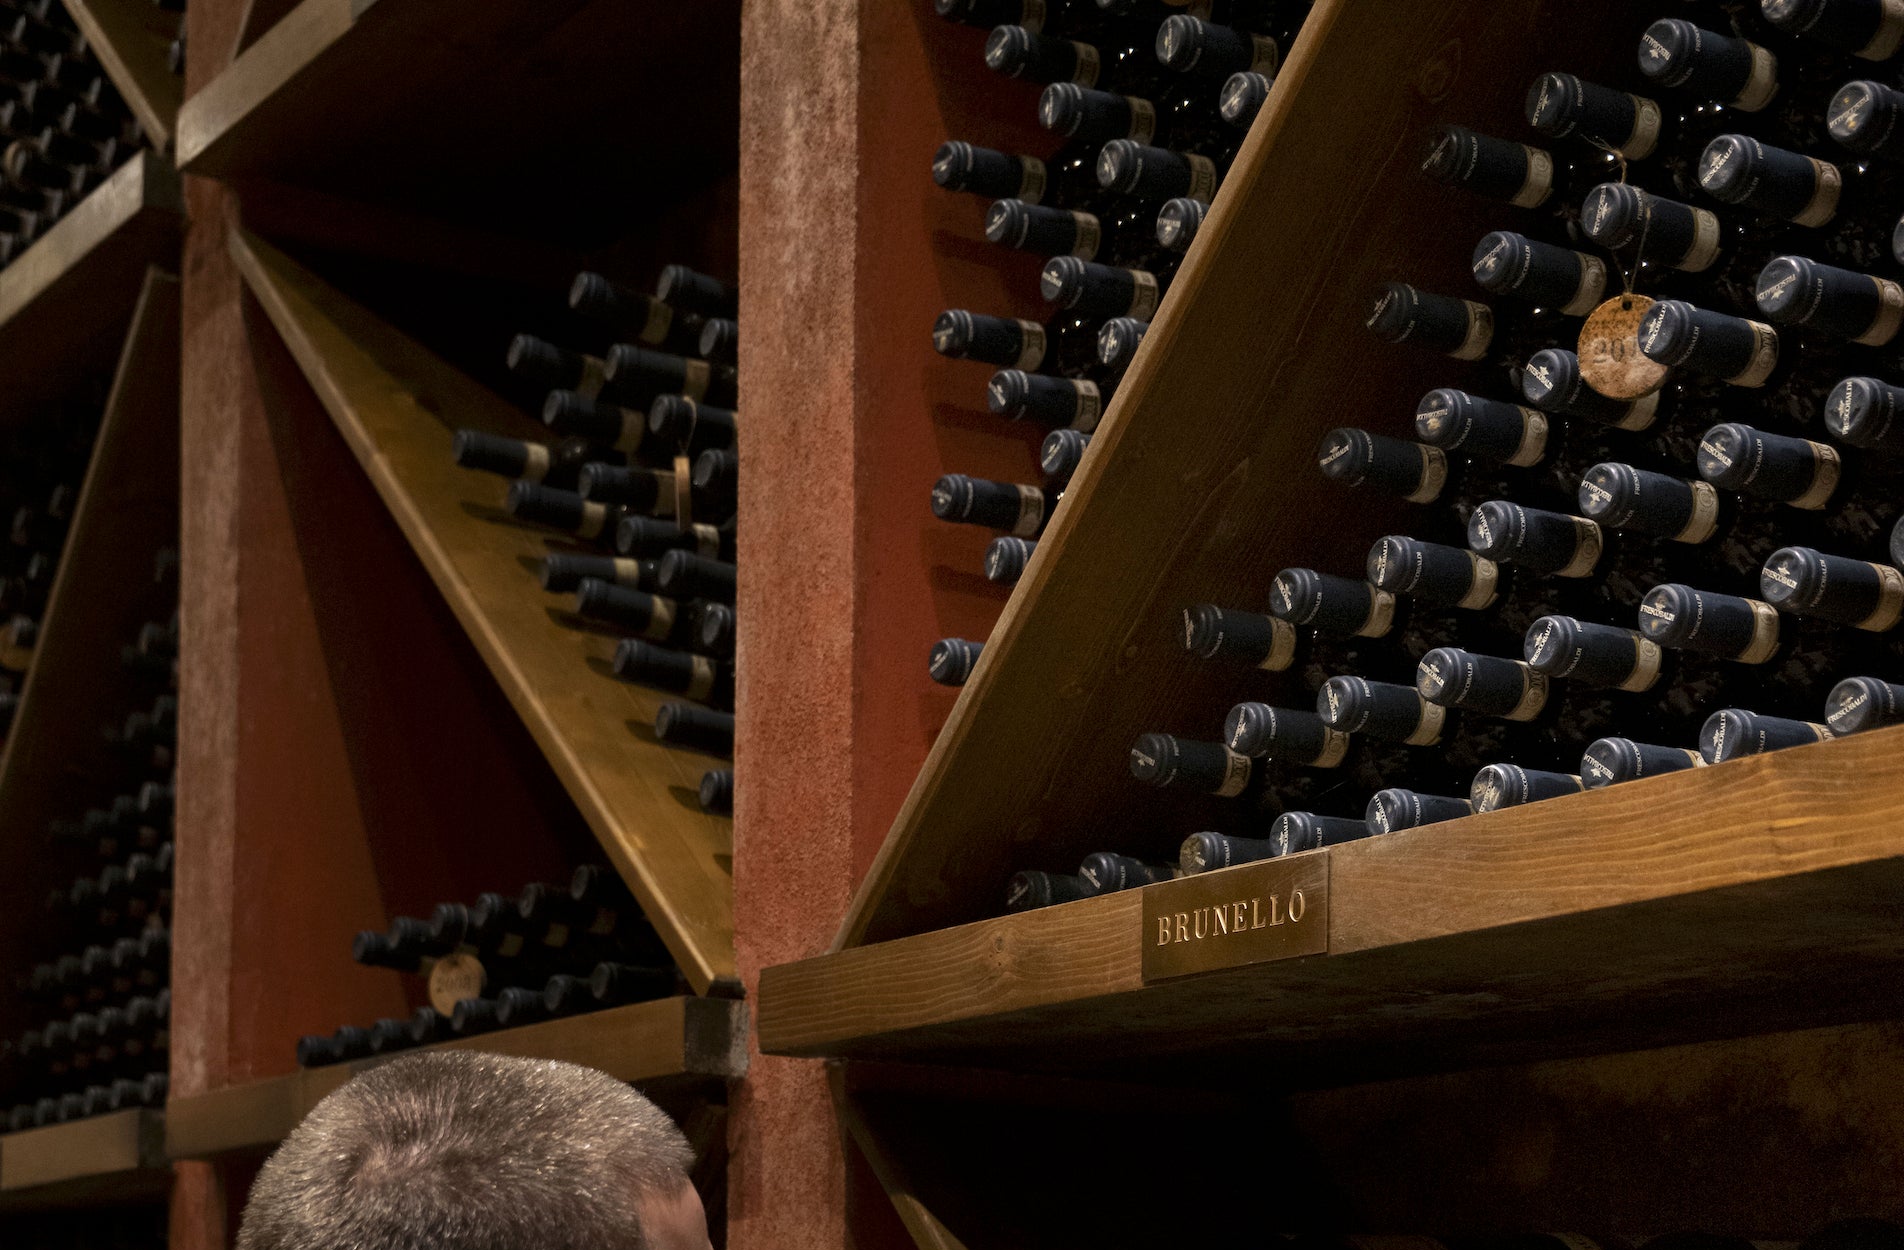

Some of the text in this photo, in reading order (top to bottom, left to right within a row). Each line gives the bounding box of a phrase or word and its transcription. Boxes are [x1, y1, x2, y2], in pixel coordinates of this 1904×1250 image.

[1642, 33, 1672, 61] FRESCOBALDI
[1700, 145, 1733, 187] FRESCOBALDI
[1756, 273, 1796, 300] FRESCOBALDI
[1644, 304, 1667, 354] FRESCOBALDI
[1527, 363, 1554, 391] FRESCOBALDI
[1842, 381, 1852, 435] FRESCOBALDI
[1701, 440, 1733, 467] FRESCOBALDI
[1581, 480, 1612, 502] FRESCOBALDI
[1476, 507, 1494, 549] FRESCOBALDI
[1377, 540, 1388, 586] FRESCOBALDI
[1762, 567, 1798, 589] FRESCOBALDI
[1640, 604, 1675, 622] FRESCOBALDI
[1529, 622, 1553, 665] FRESCOBALDI
[1418, 661, 1444, 687] FRESCOBALDI
[1828, 694, 1867, 724] FRESCOBALDI
[1714, 712, 1727, 764] FRESCOBALDI
[1583, 753, 1615, 780] FRESCOBALDI
[1157, 889, 1306, 946] BRUNELLO
